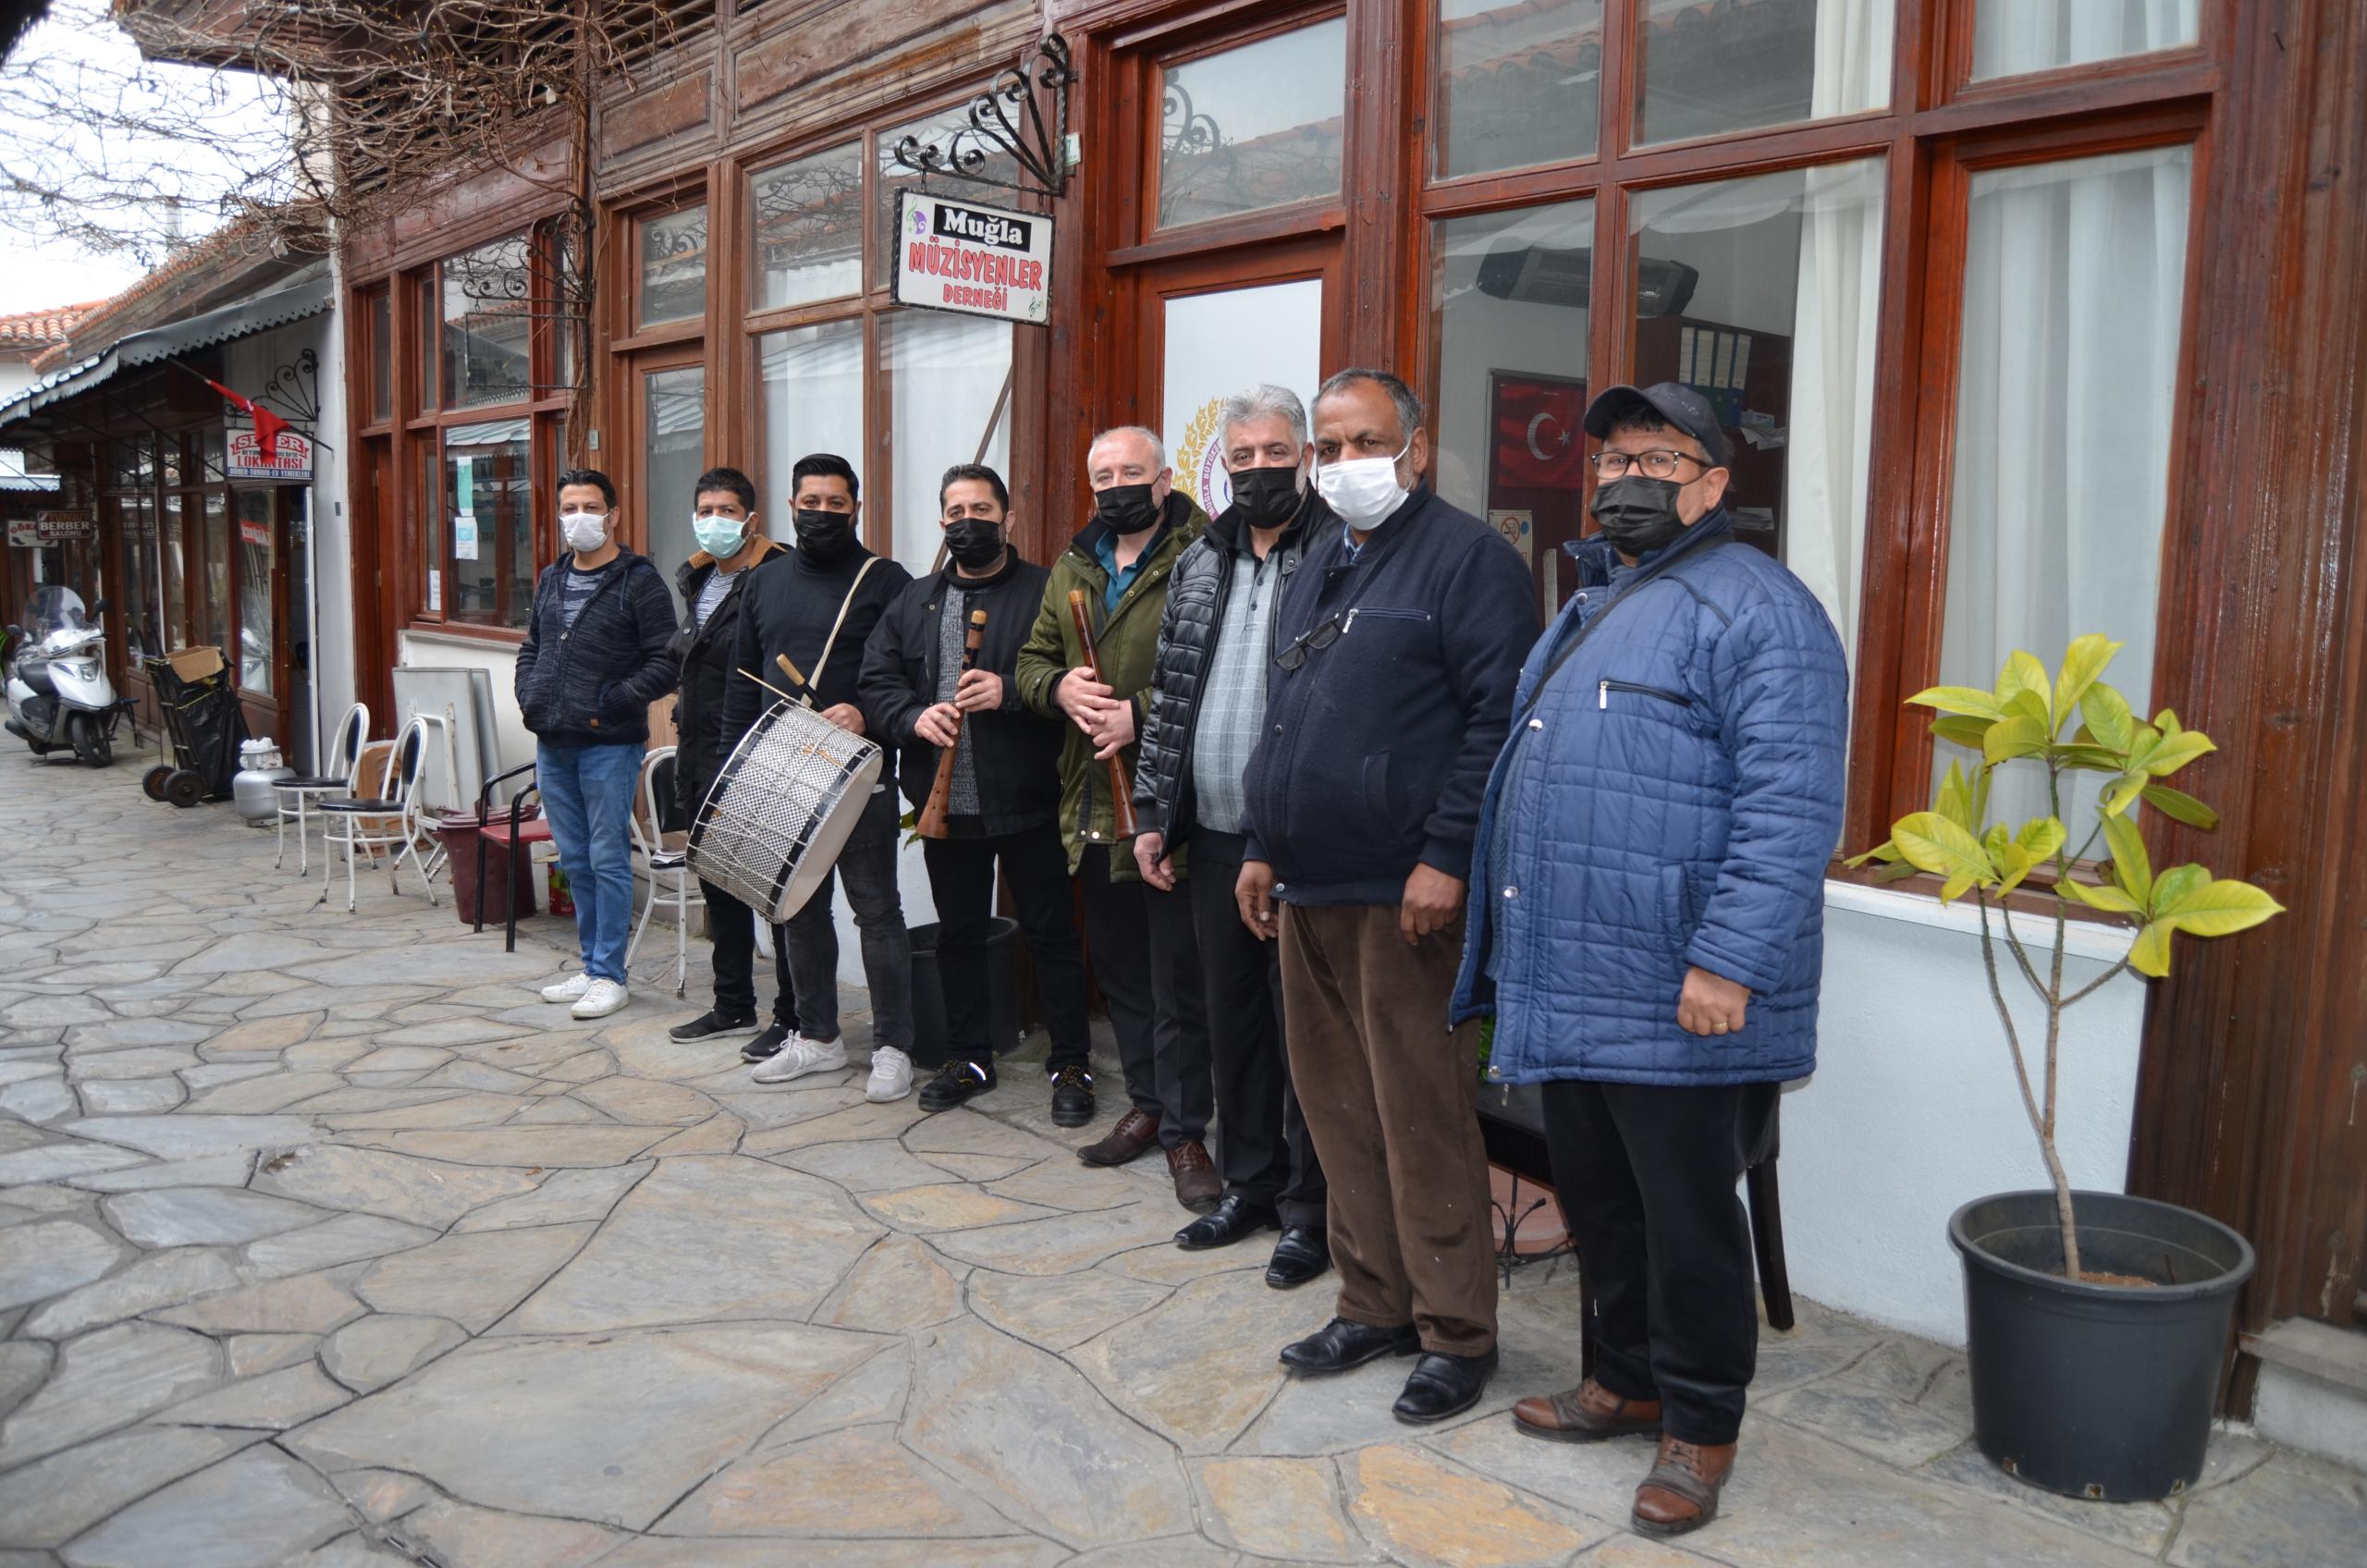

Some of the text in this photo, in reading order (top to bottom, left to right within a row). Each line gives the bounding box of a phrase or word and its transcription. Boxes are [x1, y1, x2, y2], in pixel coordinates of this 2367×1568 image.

[943, 208, 1024, 245] Muğla
[909, 236, 1043, 291] MÜZİSYENLER
[943, 283, 1008, 311] DERNEĞİ
[40, 521, 90, 531] BERBER
